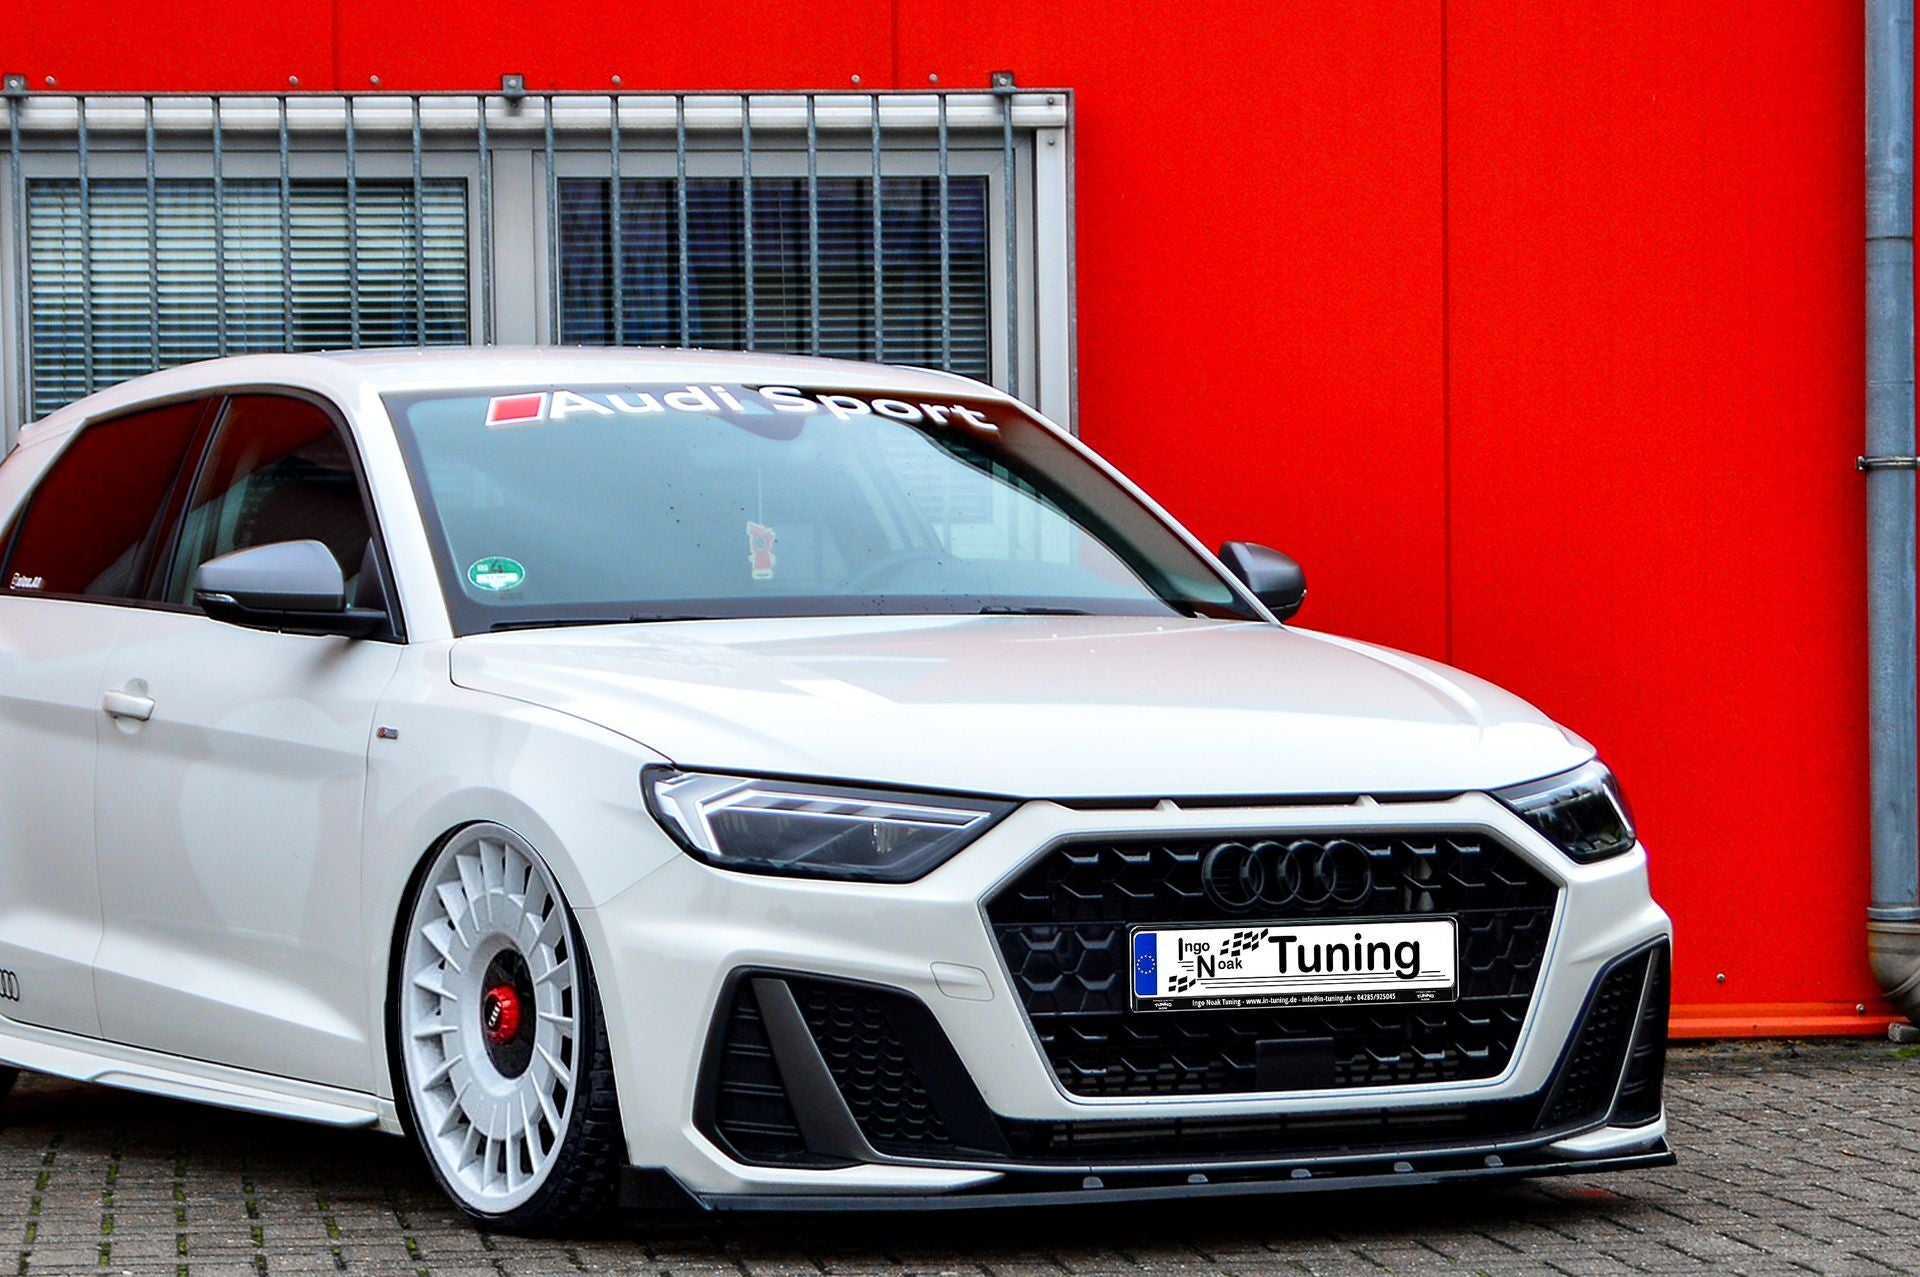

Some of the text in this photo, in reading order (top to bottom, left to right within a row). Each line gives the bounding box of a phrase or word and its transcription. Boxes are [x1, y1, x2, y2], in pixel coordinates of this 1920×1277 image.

[549, 385, 999, 430] Audi Sport
[1178, 937, 1211, 961] Ingo
[1268, 933, 1421, 980] Tuning
[1197, 954, 1243, 978] Noak
[1192, 999, 1206, 1008] Ingo
[1206, 998, 1221, 1006] Noak
[1222, 997, 1241, 1007] Tuning
[1245, 996, 1298, 1006] www.in-tuning.de
[1301, 994, 1353, 1004] info@in-tuning.de
